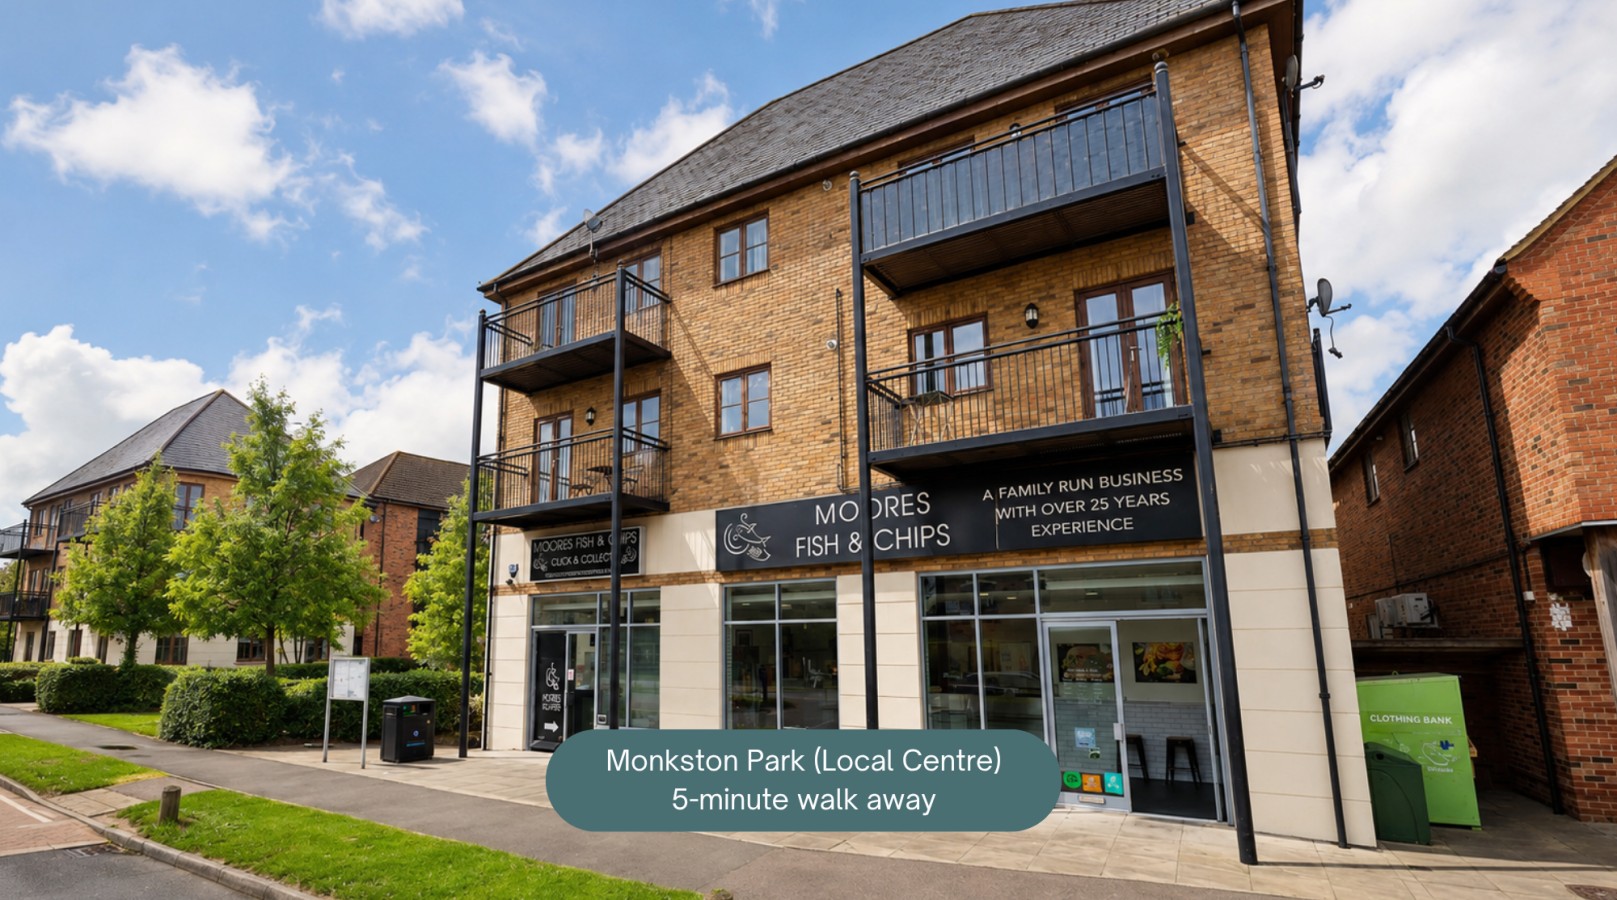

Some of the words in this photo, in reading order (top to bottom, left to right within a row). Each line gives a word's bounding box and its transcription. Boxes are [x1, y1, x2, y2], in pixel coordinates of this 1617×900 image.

[983, 489, 994, 501] A
[999, 481, 1054, 500] FAMILY
[1059, 477, 1094, 493] RUN
[1099, 468, 1184, 488] BUSINESS
[996, 505, 1037, 520] WITH
[1041, 500, 1086, 516] OVER
[1090, 497, 1109, 511] 25
[1113, 492, 1171, 509] YEARS
[1031, 517, 1135, 537] EXPERIENCE
[533, 537, 574, 554] MOORES
[575, 535, 595, 549] FISH
[597, 534, 605, 547] &
[796, 533, 839, 558] FISH
[848, 531, 862, 553] &
[873, 523, 951, 551] CHIPS
[551, 556, 572, 567] CLICK
[573, 555, 579, 565] &
[1369, 713, 1421, 724] CLOTHING
[1423, 715, 1453, 725] BANK
